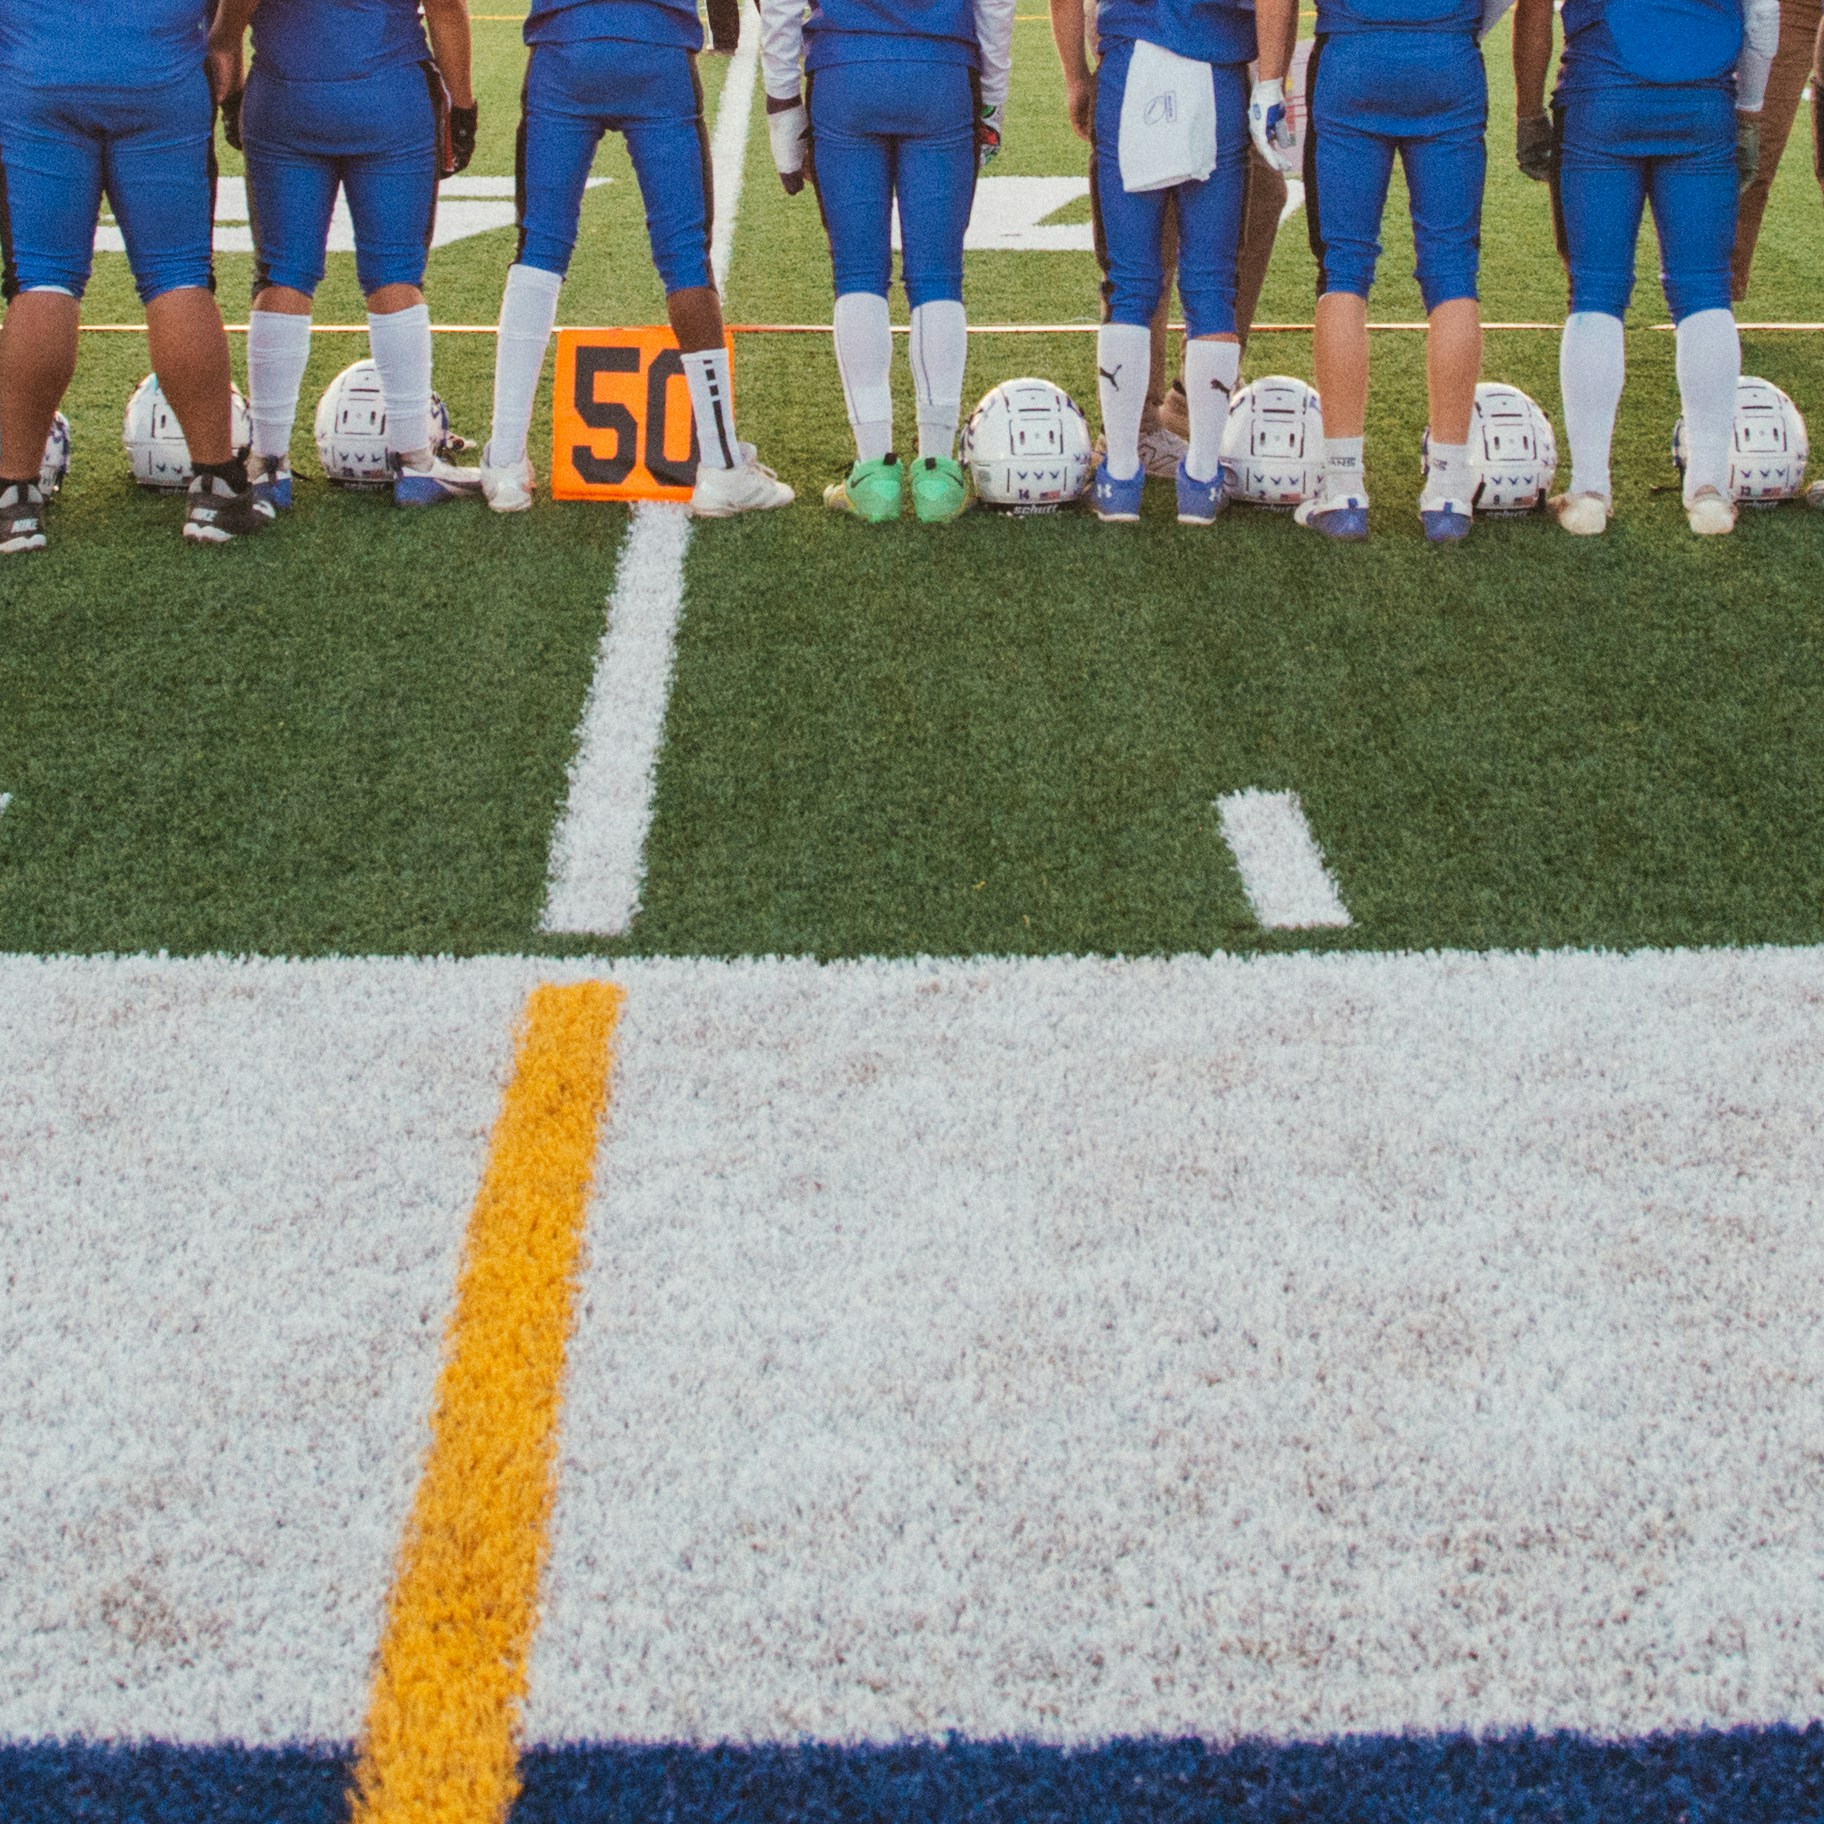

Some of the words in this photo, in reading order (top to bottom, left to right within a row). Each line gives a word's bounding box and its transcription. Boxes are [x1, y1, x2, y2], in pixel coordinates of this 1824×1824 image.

[570, 345, 701, 487] 50
[1018, 489, 1030, 501] 14
[1012, 504, 1059, 515] schutt
